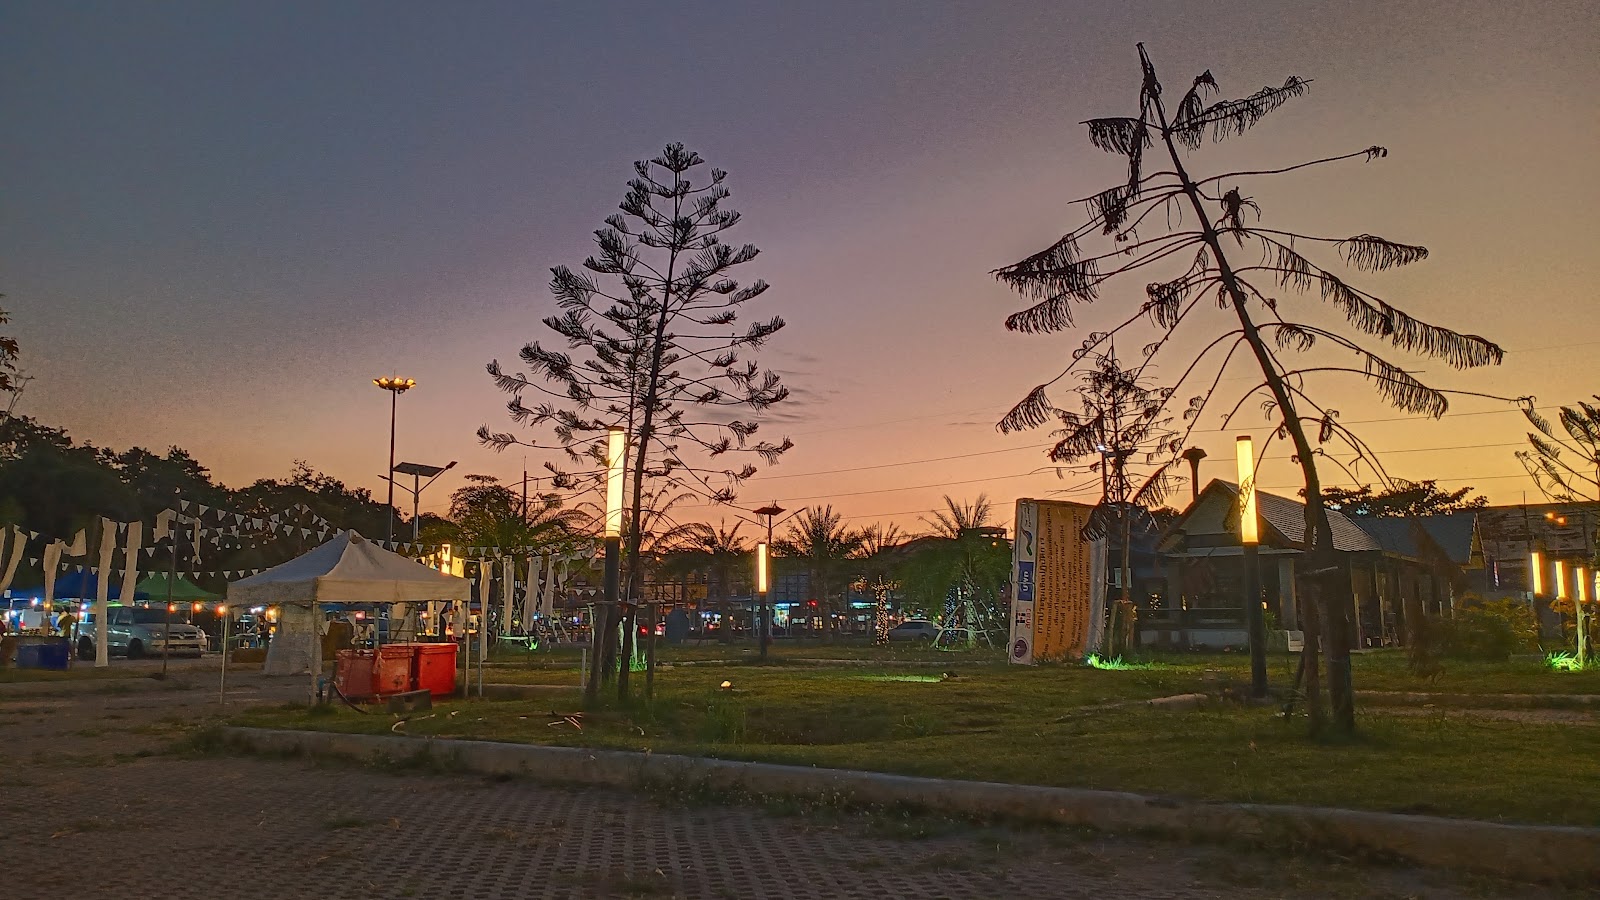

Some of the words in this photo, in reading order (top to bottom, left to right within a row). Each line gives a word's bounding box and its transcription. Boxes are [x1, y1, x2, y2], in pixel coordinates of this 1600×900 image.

[1036, 537, 1047, 634] การประชุมเชิงปฏิบัติการ
